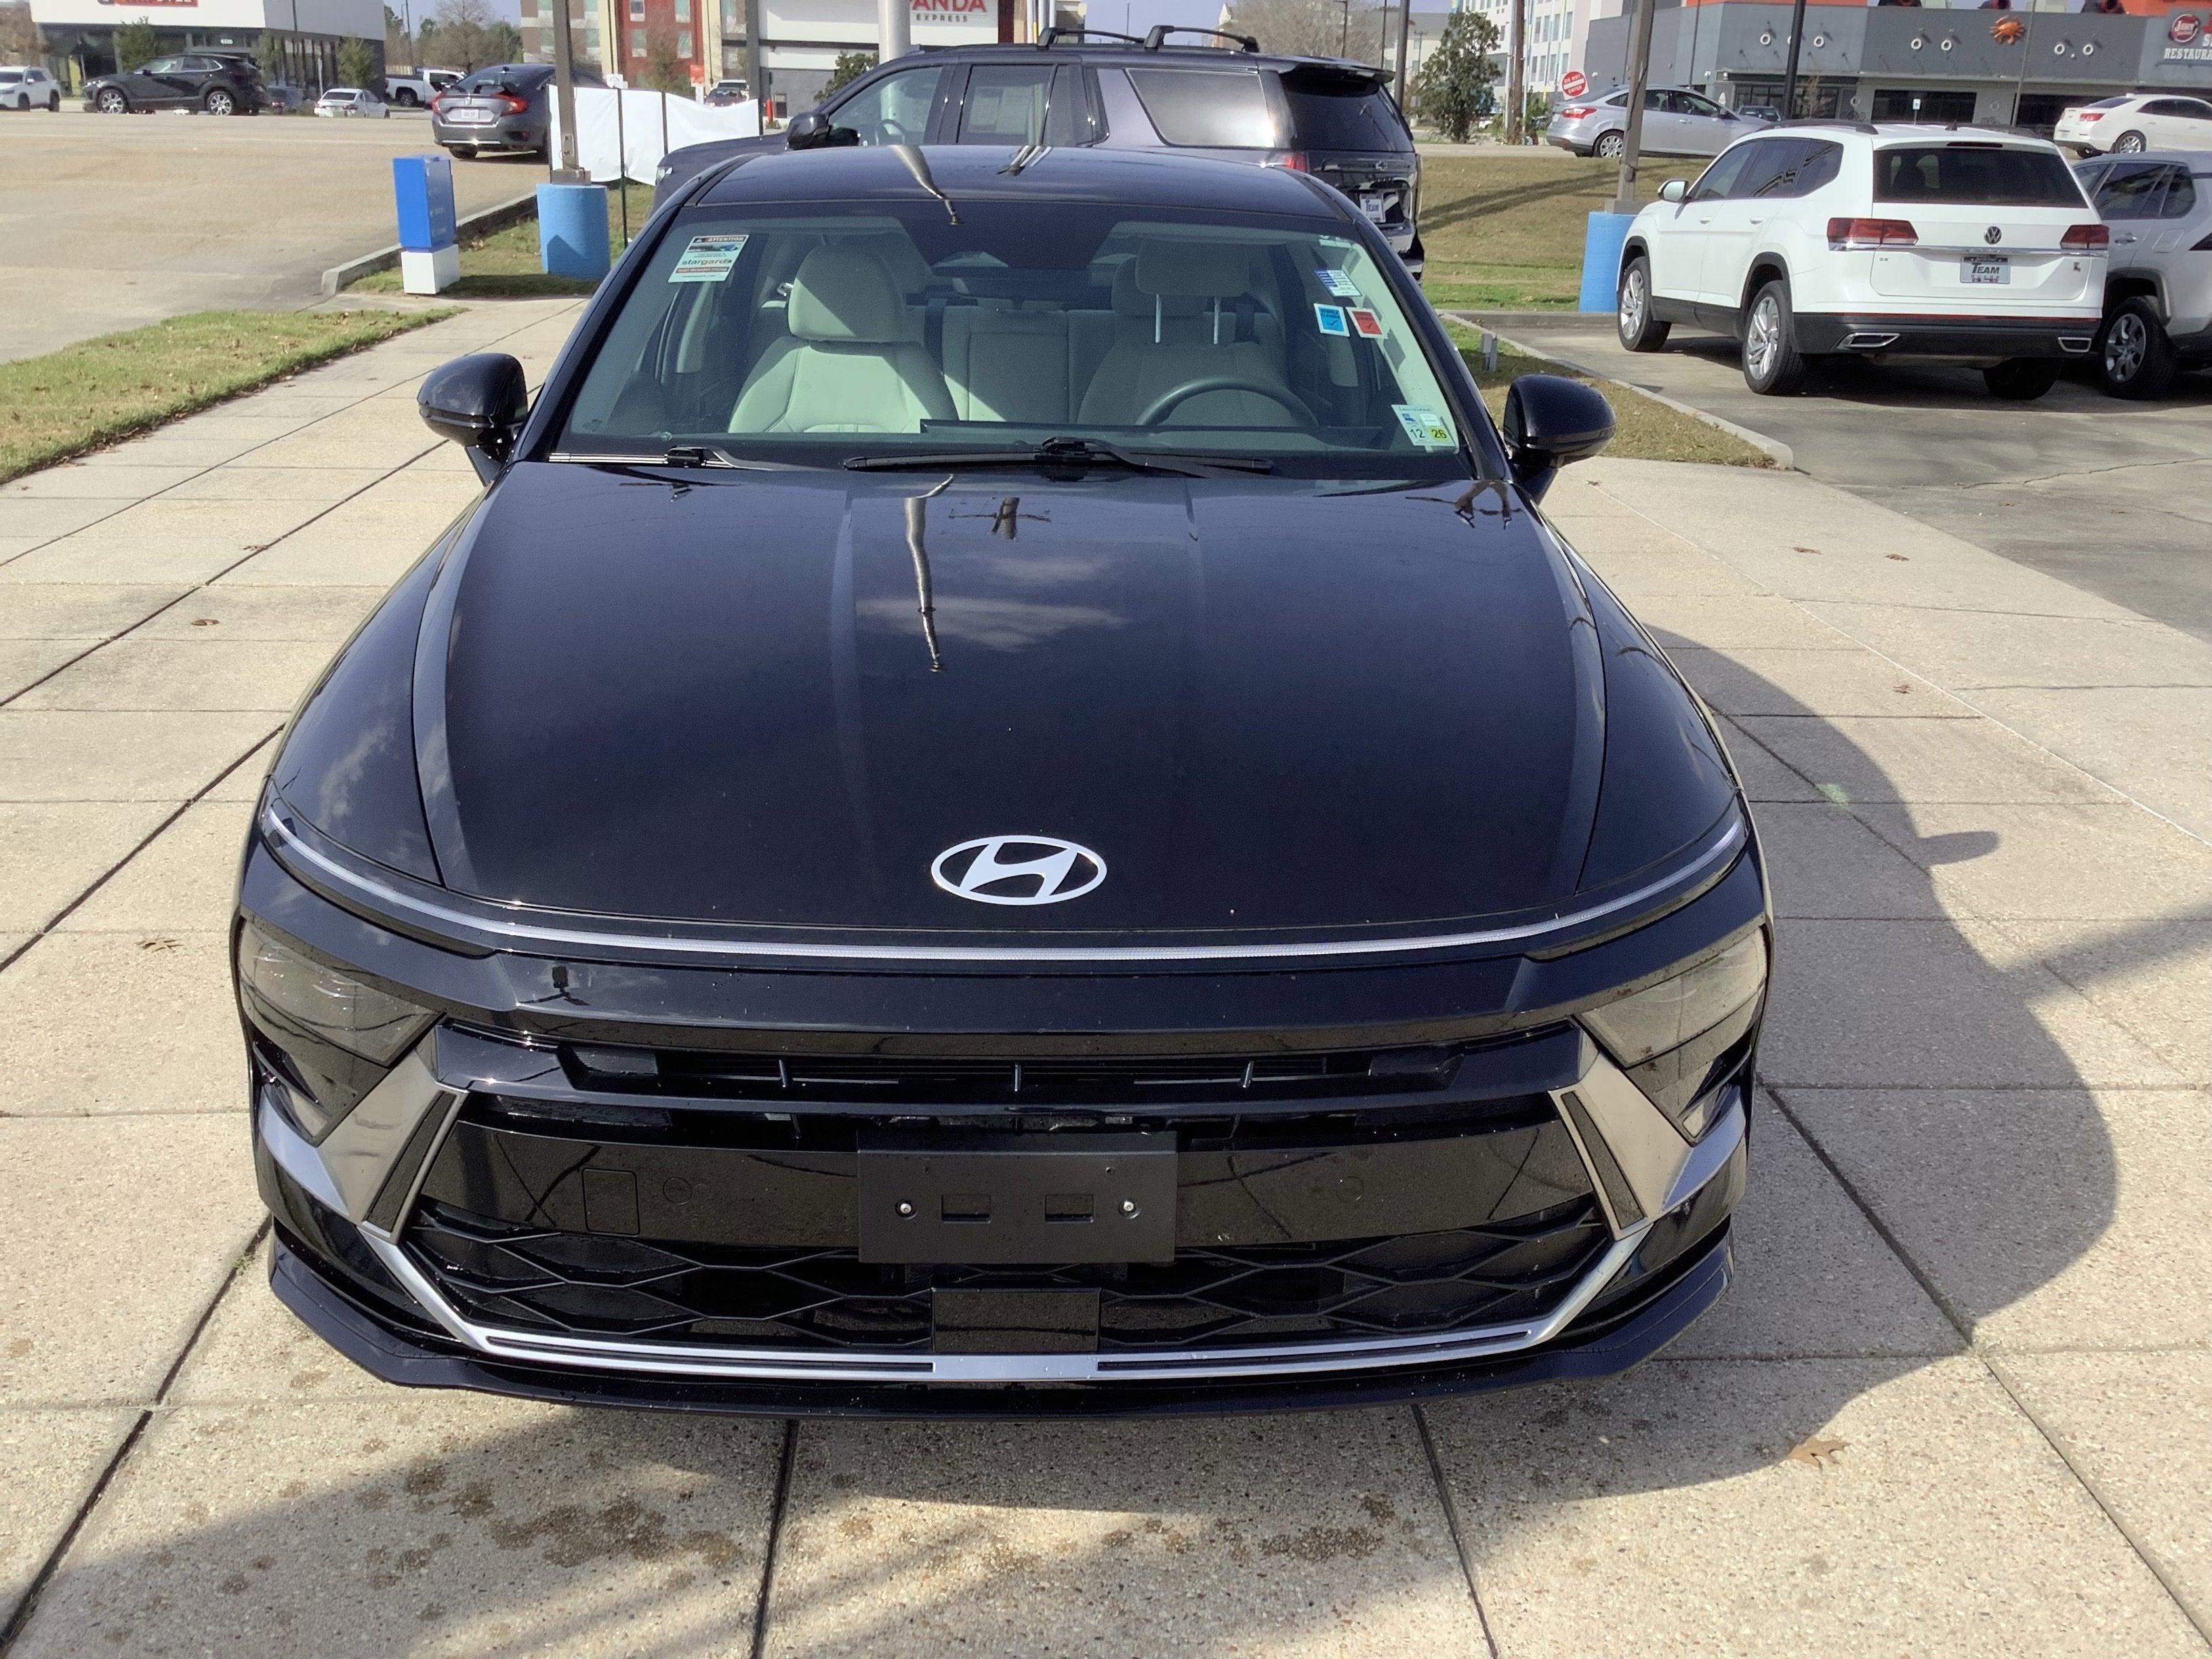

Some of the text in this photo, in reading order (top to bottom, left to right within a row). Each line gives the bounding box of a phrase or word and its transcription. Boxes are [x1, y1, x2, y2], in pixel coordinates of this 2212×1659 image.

[909, 0, 987, 12] ANDA
[916, 14, 968, 22] EXPRESS
[1971, 262, 2000, 274] TEAM
[1410, 428, 1447, 438] 12 26
